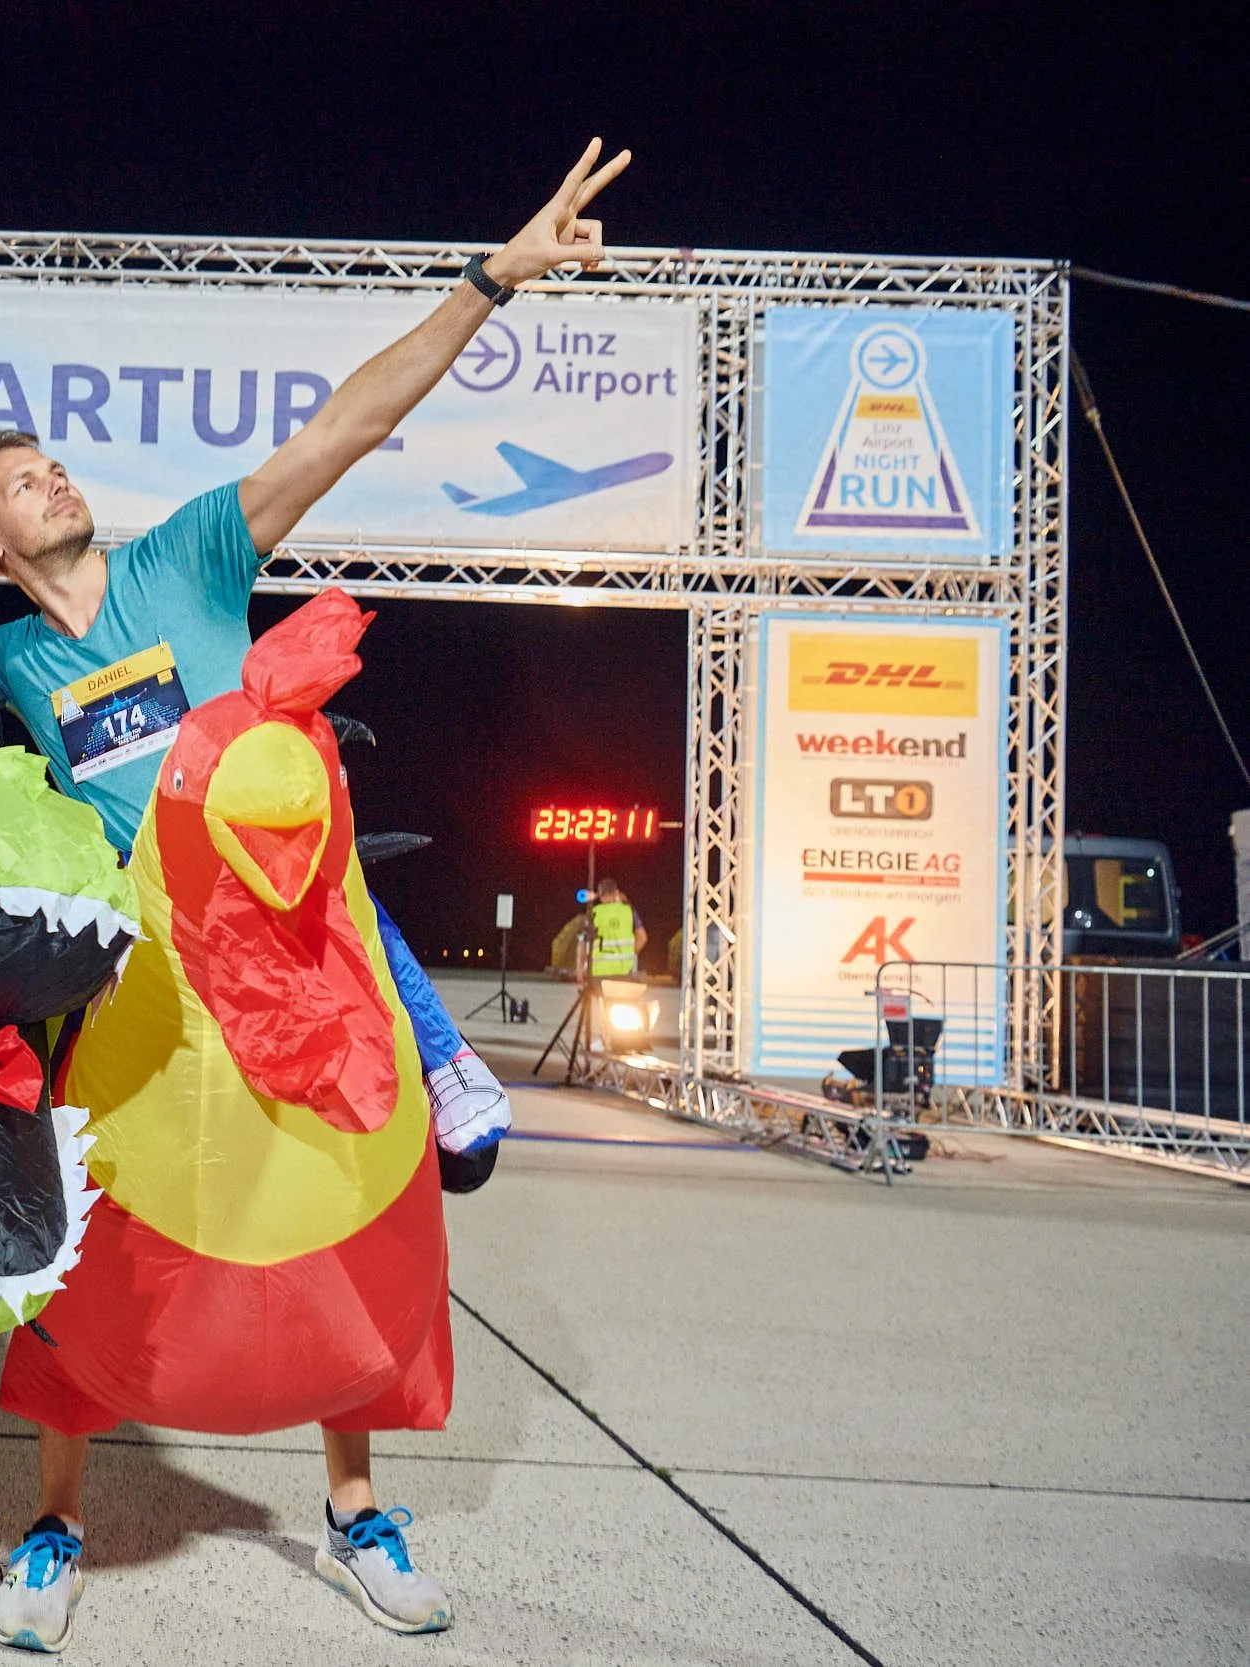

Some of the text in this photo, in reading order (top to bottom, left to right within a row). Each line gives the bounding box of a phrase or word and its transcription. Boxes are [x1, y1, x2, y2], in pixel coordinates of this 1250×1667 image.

[535, 322, 616, 356] Linz
[533, 361, 677, 400] Airport
[862, 435, 913, 450] Airport
[854, 453, 921, 470] NIGHT
[840, 473, 936, 509] RUN
[87, 665, 132, 691] DANIEL
[825, 662, 943, 688] DHL
[102, 704, 146, 740] 174
[796, 729, 967, 758] weekend
[534, 809, 653, 841] 23:23:11
[802, 848, 962, 874] ENERGIE AG
[840, 915, 917, 966] AK
